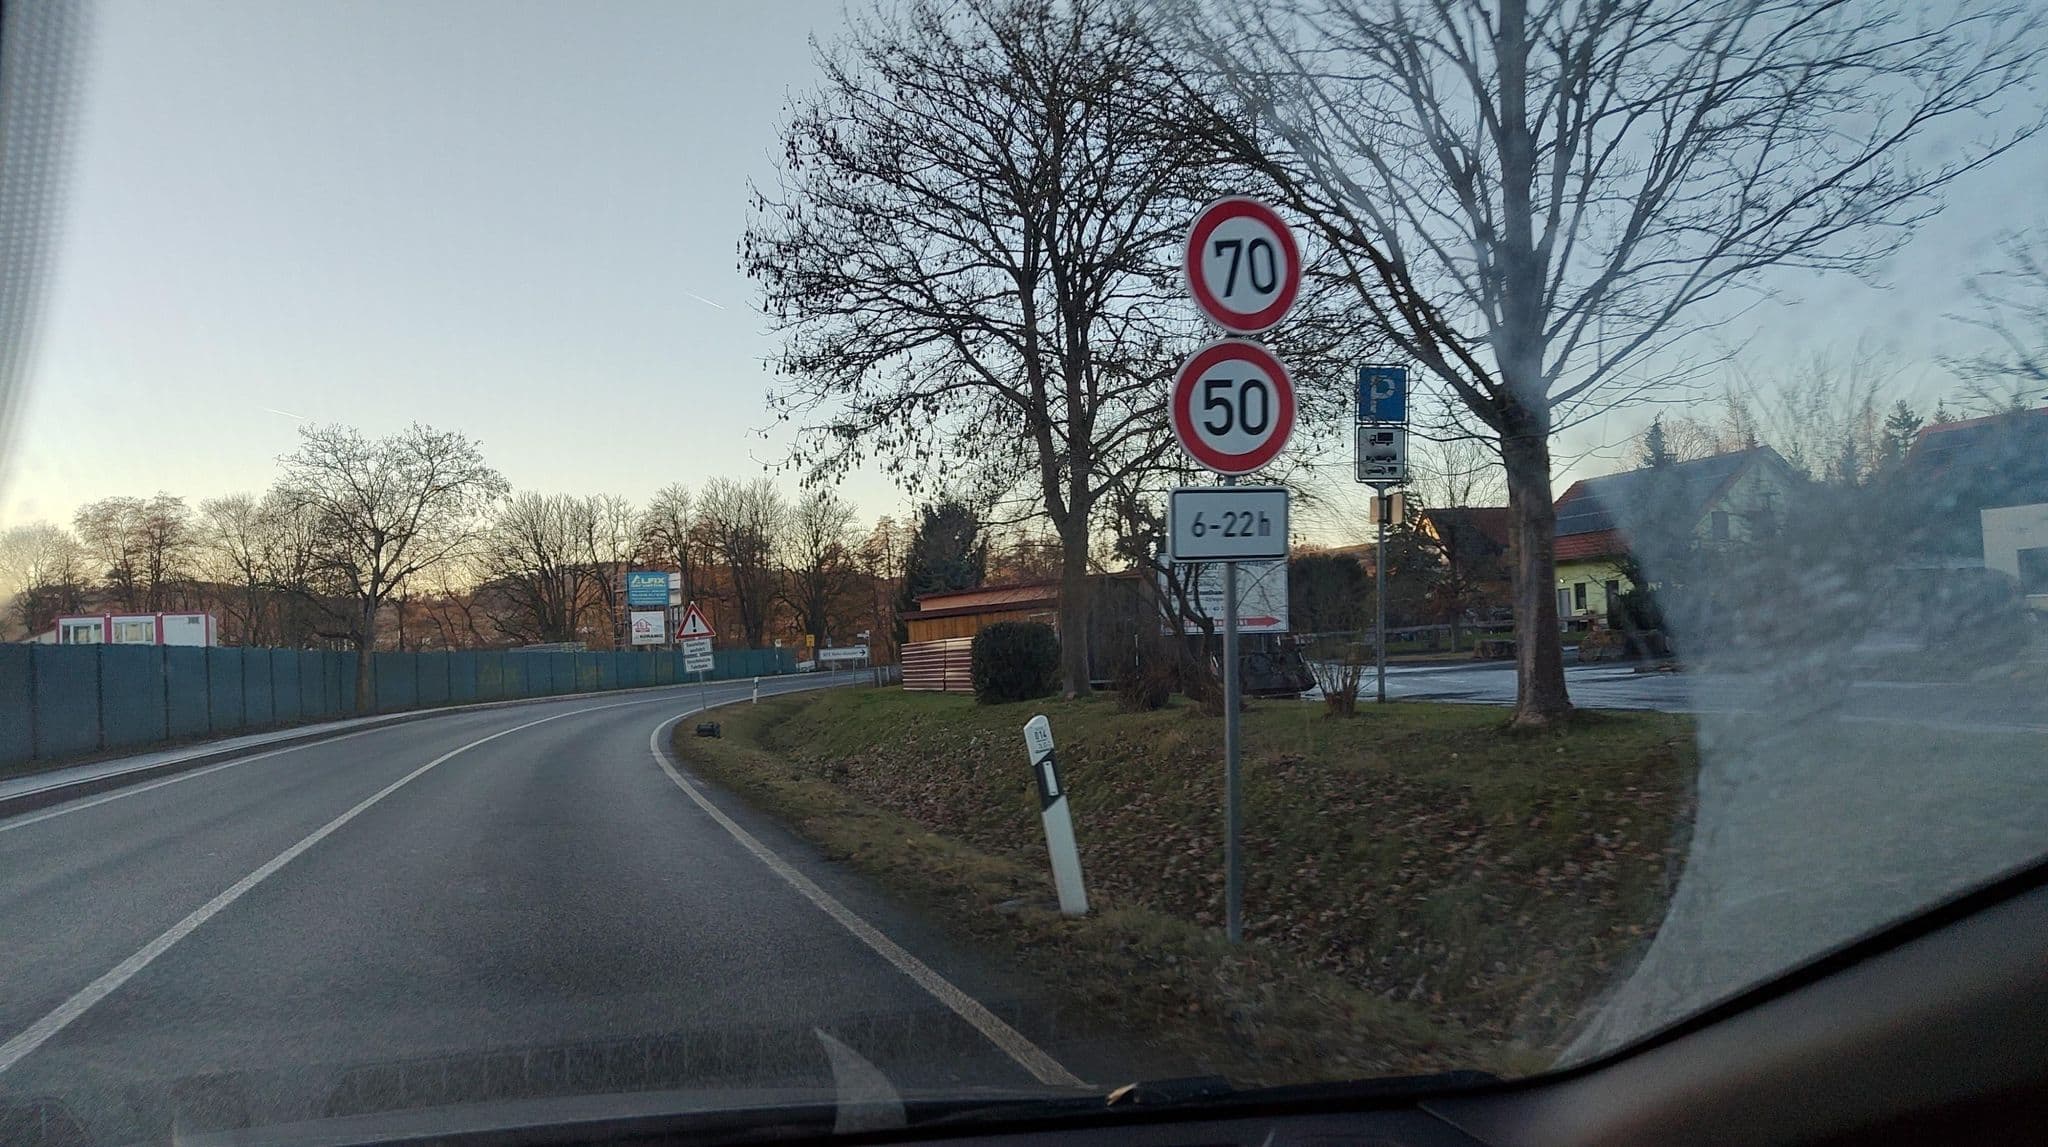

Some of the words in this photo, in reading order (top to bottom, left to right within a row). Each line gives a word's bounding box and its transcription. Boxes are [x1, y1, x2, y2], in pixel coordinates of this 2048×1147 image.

[1214, 237, 1277, 298] 70
[1203, 378, 1269, 436] 50
[1370, 375, 1396, 413] P
